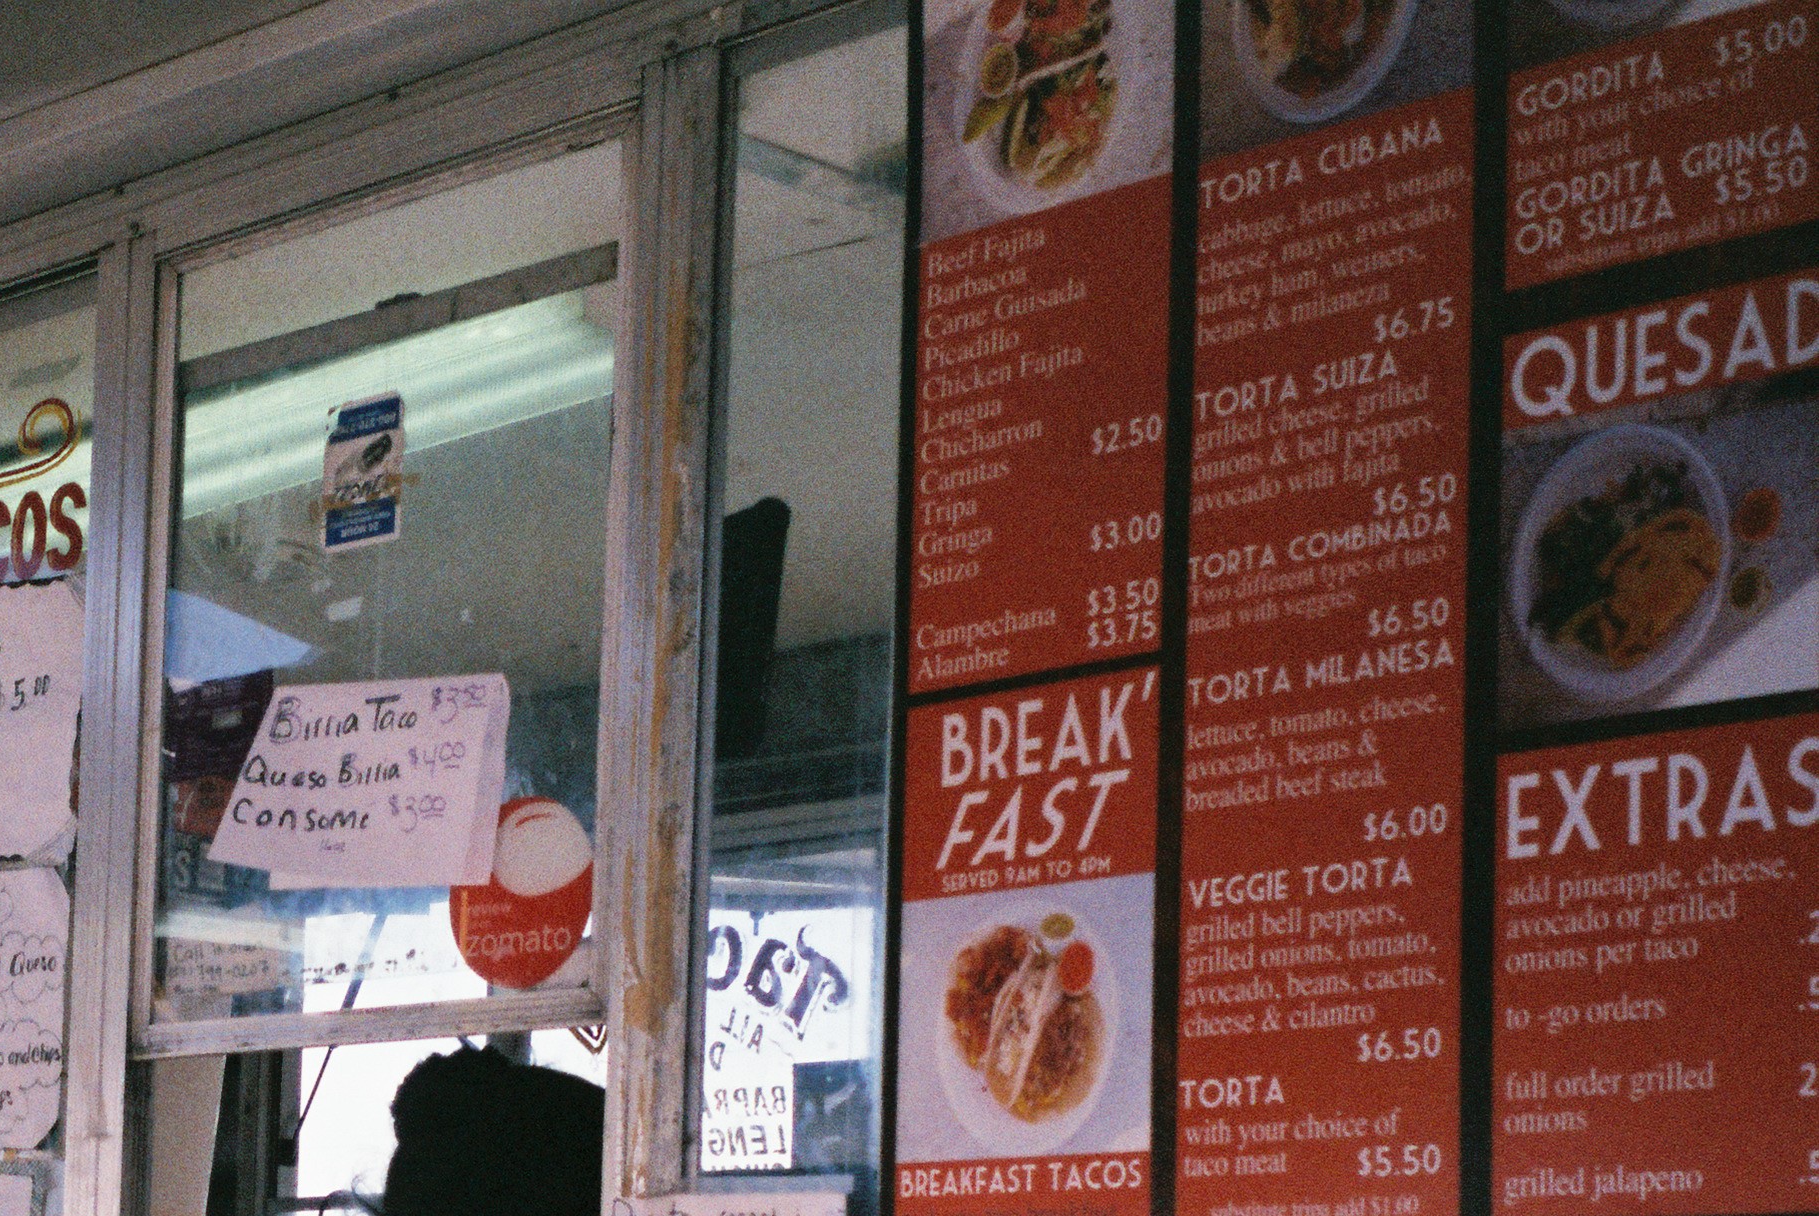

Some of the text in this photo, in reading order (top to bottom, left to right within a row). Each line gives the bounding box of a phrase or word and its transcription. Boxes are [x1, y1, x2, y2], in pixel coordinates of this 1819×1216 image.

[1516, 14, 1807, 116] GORDITA $5.00
[1200, 117, 1443, 209] TORTA CUBANA
[1515, 121, 1809, 220] GORDITA GRINGA
[1515, 155, 1808, 255] OR SUIZA $5.50
[927, 227, 1046, 278] Beef Fajita
[924, 277, 1087, 340] Carne Guisada
[927, 265, 1027, 309] Barbacoa
[1374, 295, 1455, 343] $6.75
[924, 328, 1020, 372] Picadillo
[922, 345, 1085, 402] Chicken Fajita
[1195, 349, 1398, 422] TORTA SUIZA
[922, 398, 1002, 434] Lengua
[920, 412, 1163, 464] Chicharron $2.50
[919, 457, 1010, 494] Carnitas
[1373, 472, 1457, 517] $6.50
[1090, 510, 1162, 553] $3.00
[1189, 509, 1452, 583] TORTA COMBINADA
[1087, 576, 1159, 617] $3.50
[1368, 595, 1451, 638] $6.50
[915, 607, 1158, 650] Campechana $3.75
[915, 646, 1010, 683] Alambre
[1188, 636, 1455, 707] TORTA MILANESA
[364, 693, 419, 733] Taco
[936, 768, 1131, 871] FAST
[1506, 736, 1819, 860] EXTRAS
[1363, 802, 1448, 843] $6.00
[941, 869, 1000, 893] SERVED
[1045, 859, 1073, 879] TO
[1188, 855, 1414, 910] VEGGIE TORTA
[1185, 912, 1255, 951] grilled
[1505, 890, 1737, 940] avocado or grilled
[465, 923, 572, 958] zomato
[1504, 935, 1699, 975] onions per taco
[8, 951, 58, 978] Queso
[1185, 943, 1255, 983] grilled
[1183, 1000, 1376, 1039] cheese & cilantro
[1585, 990, 1668, 1024] orders
[1356, 1026, 1443, 1064] $6.50
[1179, 1075, 1286, 1111] TORTA
[1504, 1058, 1716, 1103] full order grilled
[1184, 1110, 1369, 1151] with your choice
[1503, 1103, 1588, 1135] onions
[898, 1158, 1143, 1199] BREAKFAST TACOS
[1183, 1143, 1443, 1179] taco meat $5.50
[1503, 1162, 1705, 1207] grilled jalapeno
